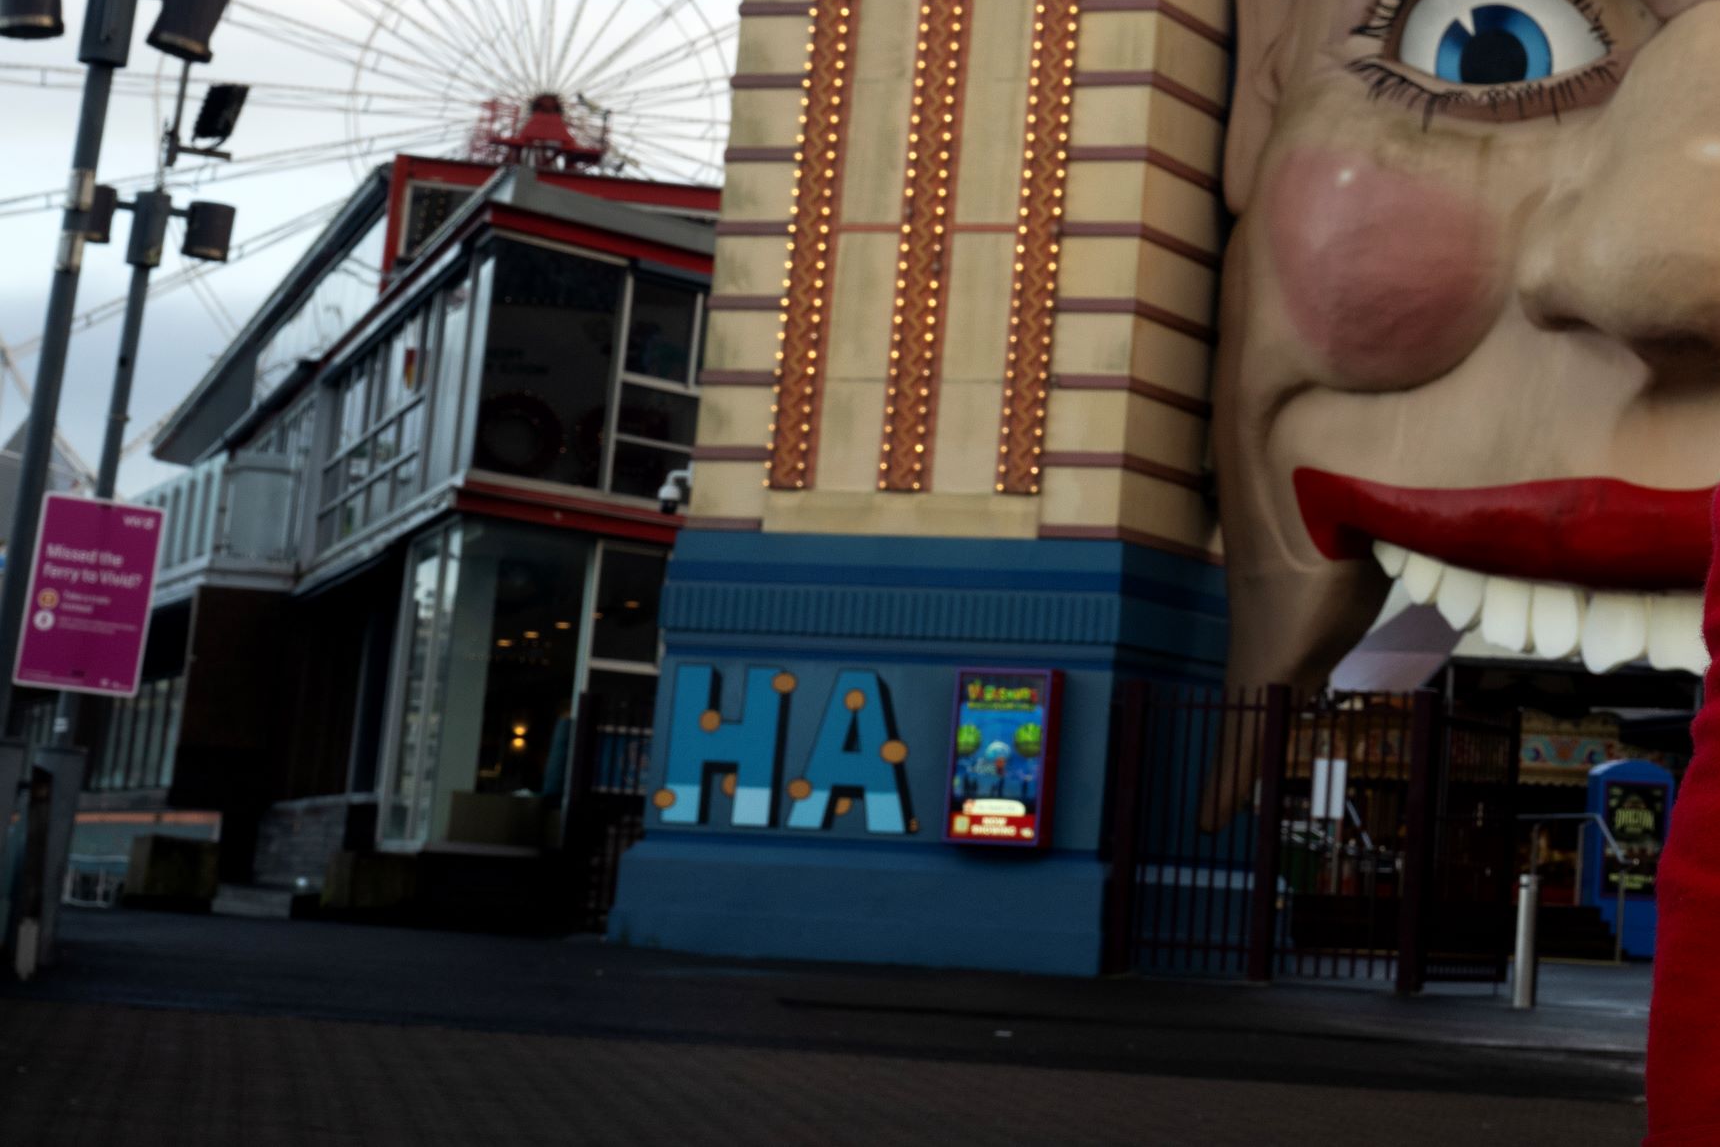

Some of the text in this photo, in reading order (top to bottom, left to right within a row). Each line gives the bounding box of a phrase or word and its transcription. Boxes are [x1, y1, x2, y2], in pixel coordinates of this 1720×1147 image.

[46, 542, 124, 566] Missed the
[43, 562, 143, 589] ferry to Vivid?
[658, 662, 910, 835] HA
